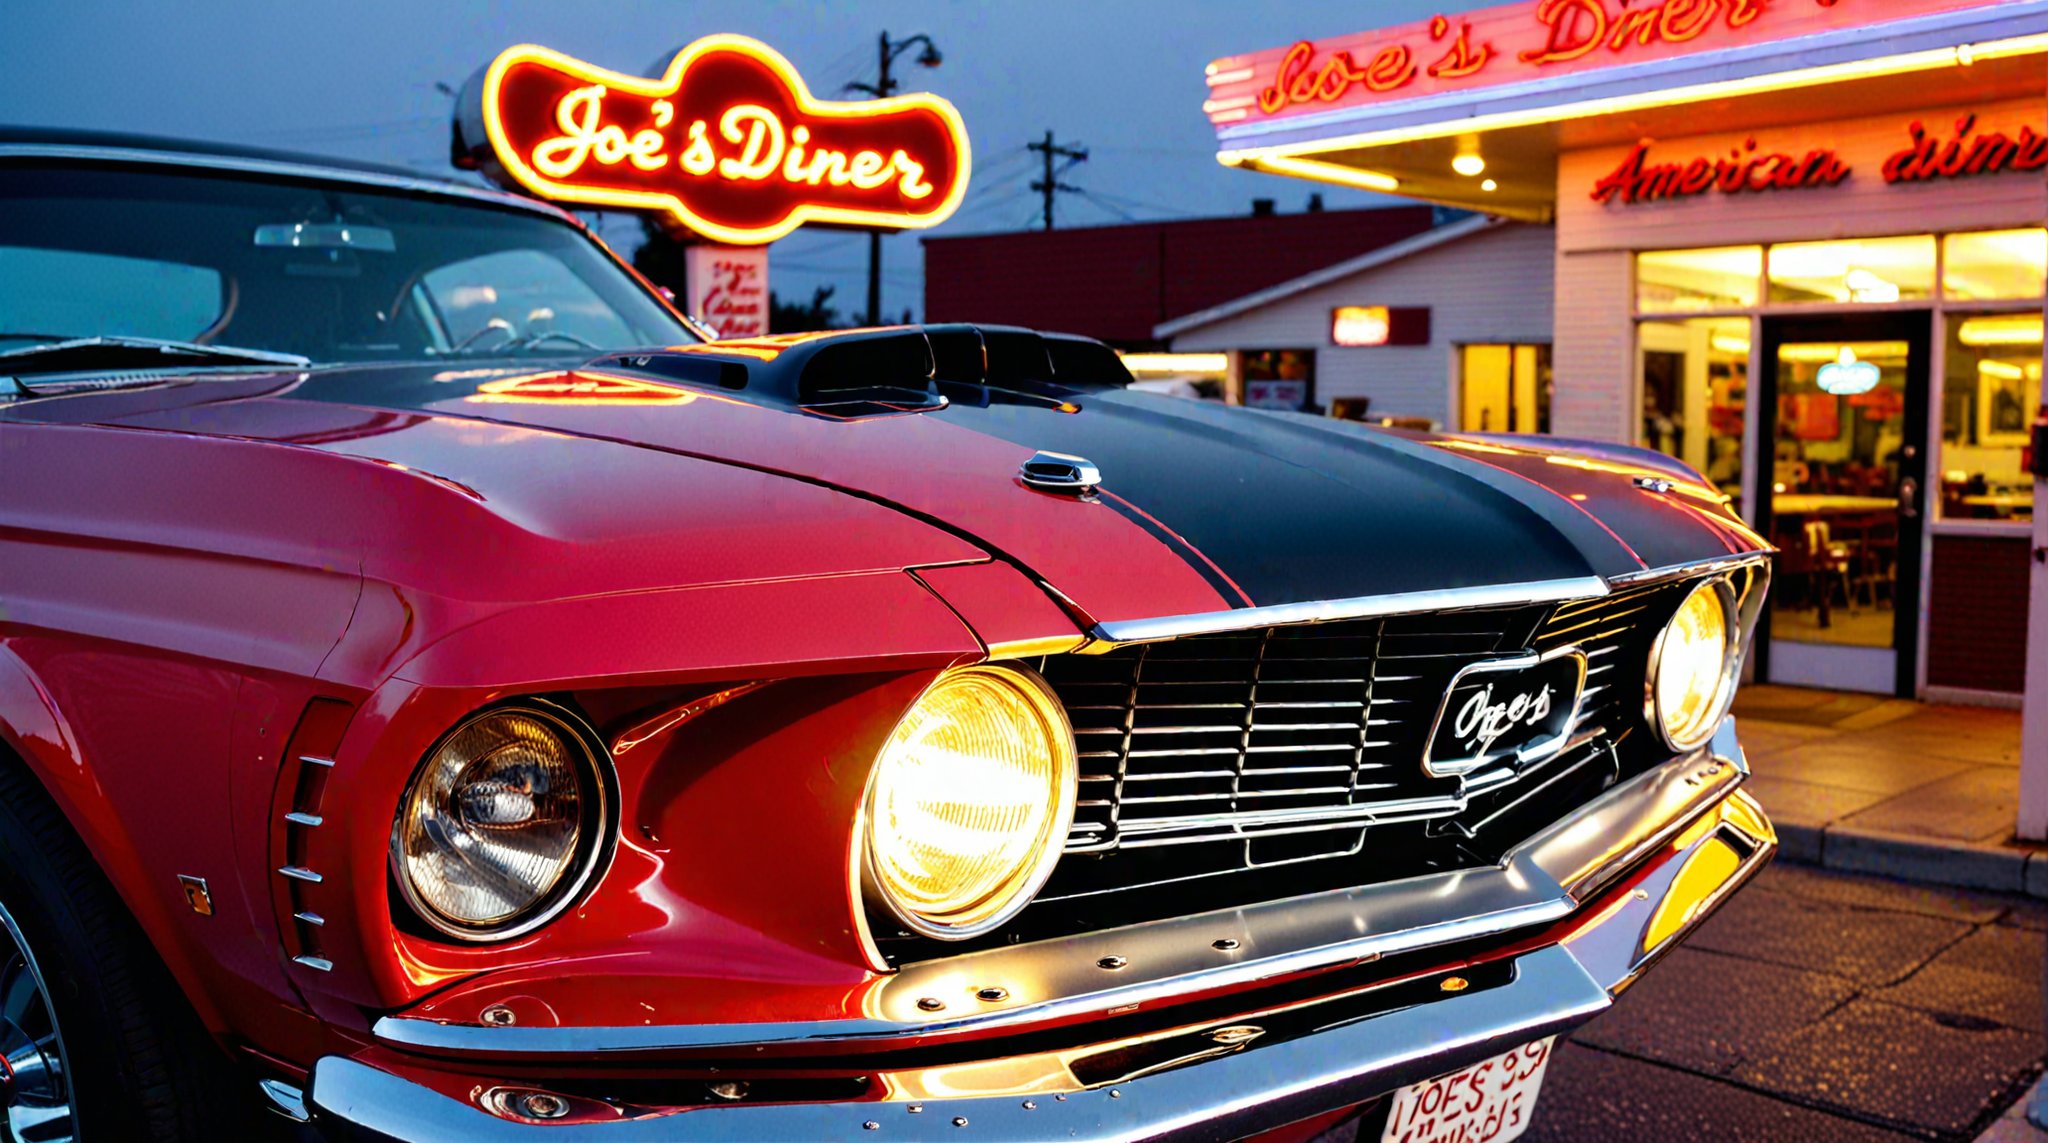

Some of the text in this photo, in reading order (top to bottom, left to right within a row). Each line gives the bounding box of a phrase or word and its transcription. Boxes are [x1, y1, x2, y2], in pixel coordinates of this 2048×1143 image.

[531, 83, 933, 200] Joe's Diner
[1589, 136, 1851, 205] American
